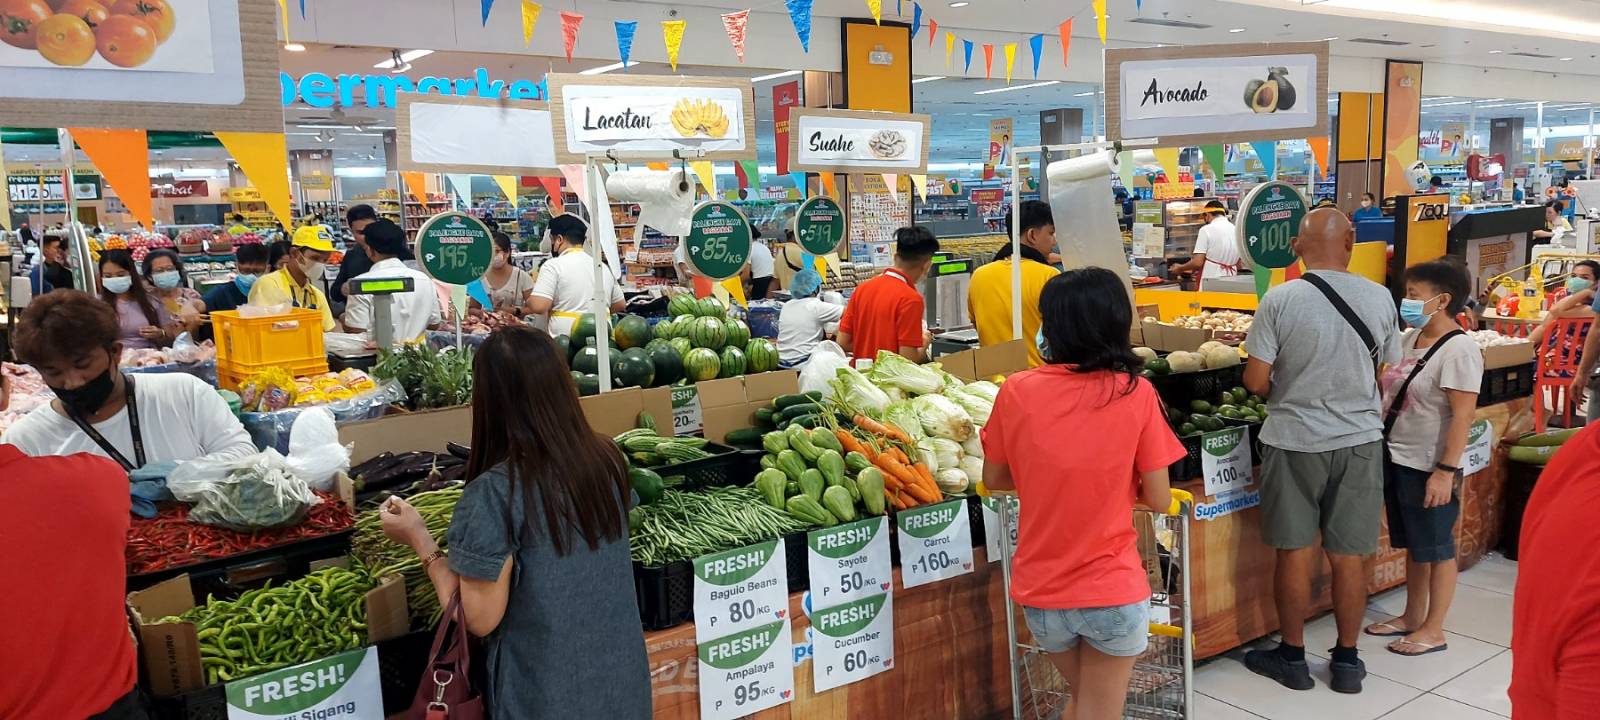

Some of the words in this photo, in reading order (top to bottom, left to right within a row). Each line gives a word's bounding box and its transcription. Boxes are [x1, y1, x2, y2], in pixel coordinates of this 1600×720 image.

[279, 67, 548, 108] ermarke
[1139, 78, 1210, 107] Avocado
[583, 106, 652, 131] Lacatan
[808, 131, 855, 152] Suahe
[439, 244, 468, 270] 195
[671, 389, 693, 401] ESH!
[1206, 432, 1239, 450] FRESH!
[1195, 493, 1259, 518] Supermarket
[904, 508, 953, 531] FRESH!
[817, 526, 871, 551] FRESH!
[924, 536, 951, 548] Carrot
[703, 549, 765, 579] FRESH!
[838, 555, 868, 569] Sayote
[710, 586, 745, 601] Baguio
[747, 577, 778, 592] Beans
[820, 603, 875, 631] FRESH!
[708, 631, 770, 663] FRESH!
[834, 631, 881, 649] Cucumber
[726, 661, 775, 682] Ampalaya
[244, 662, 346, 708] FRESH!
